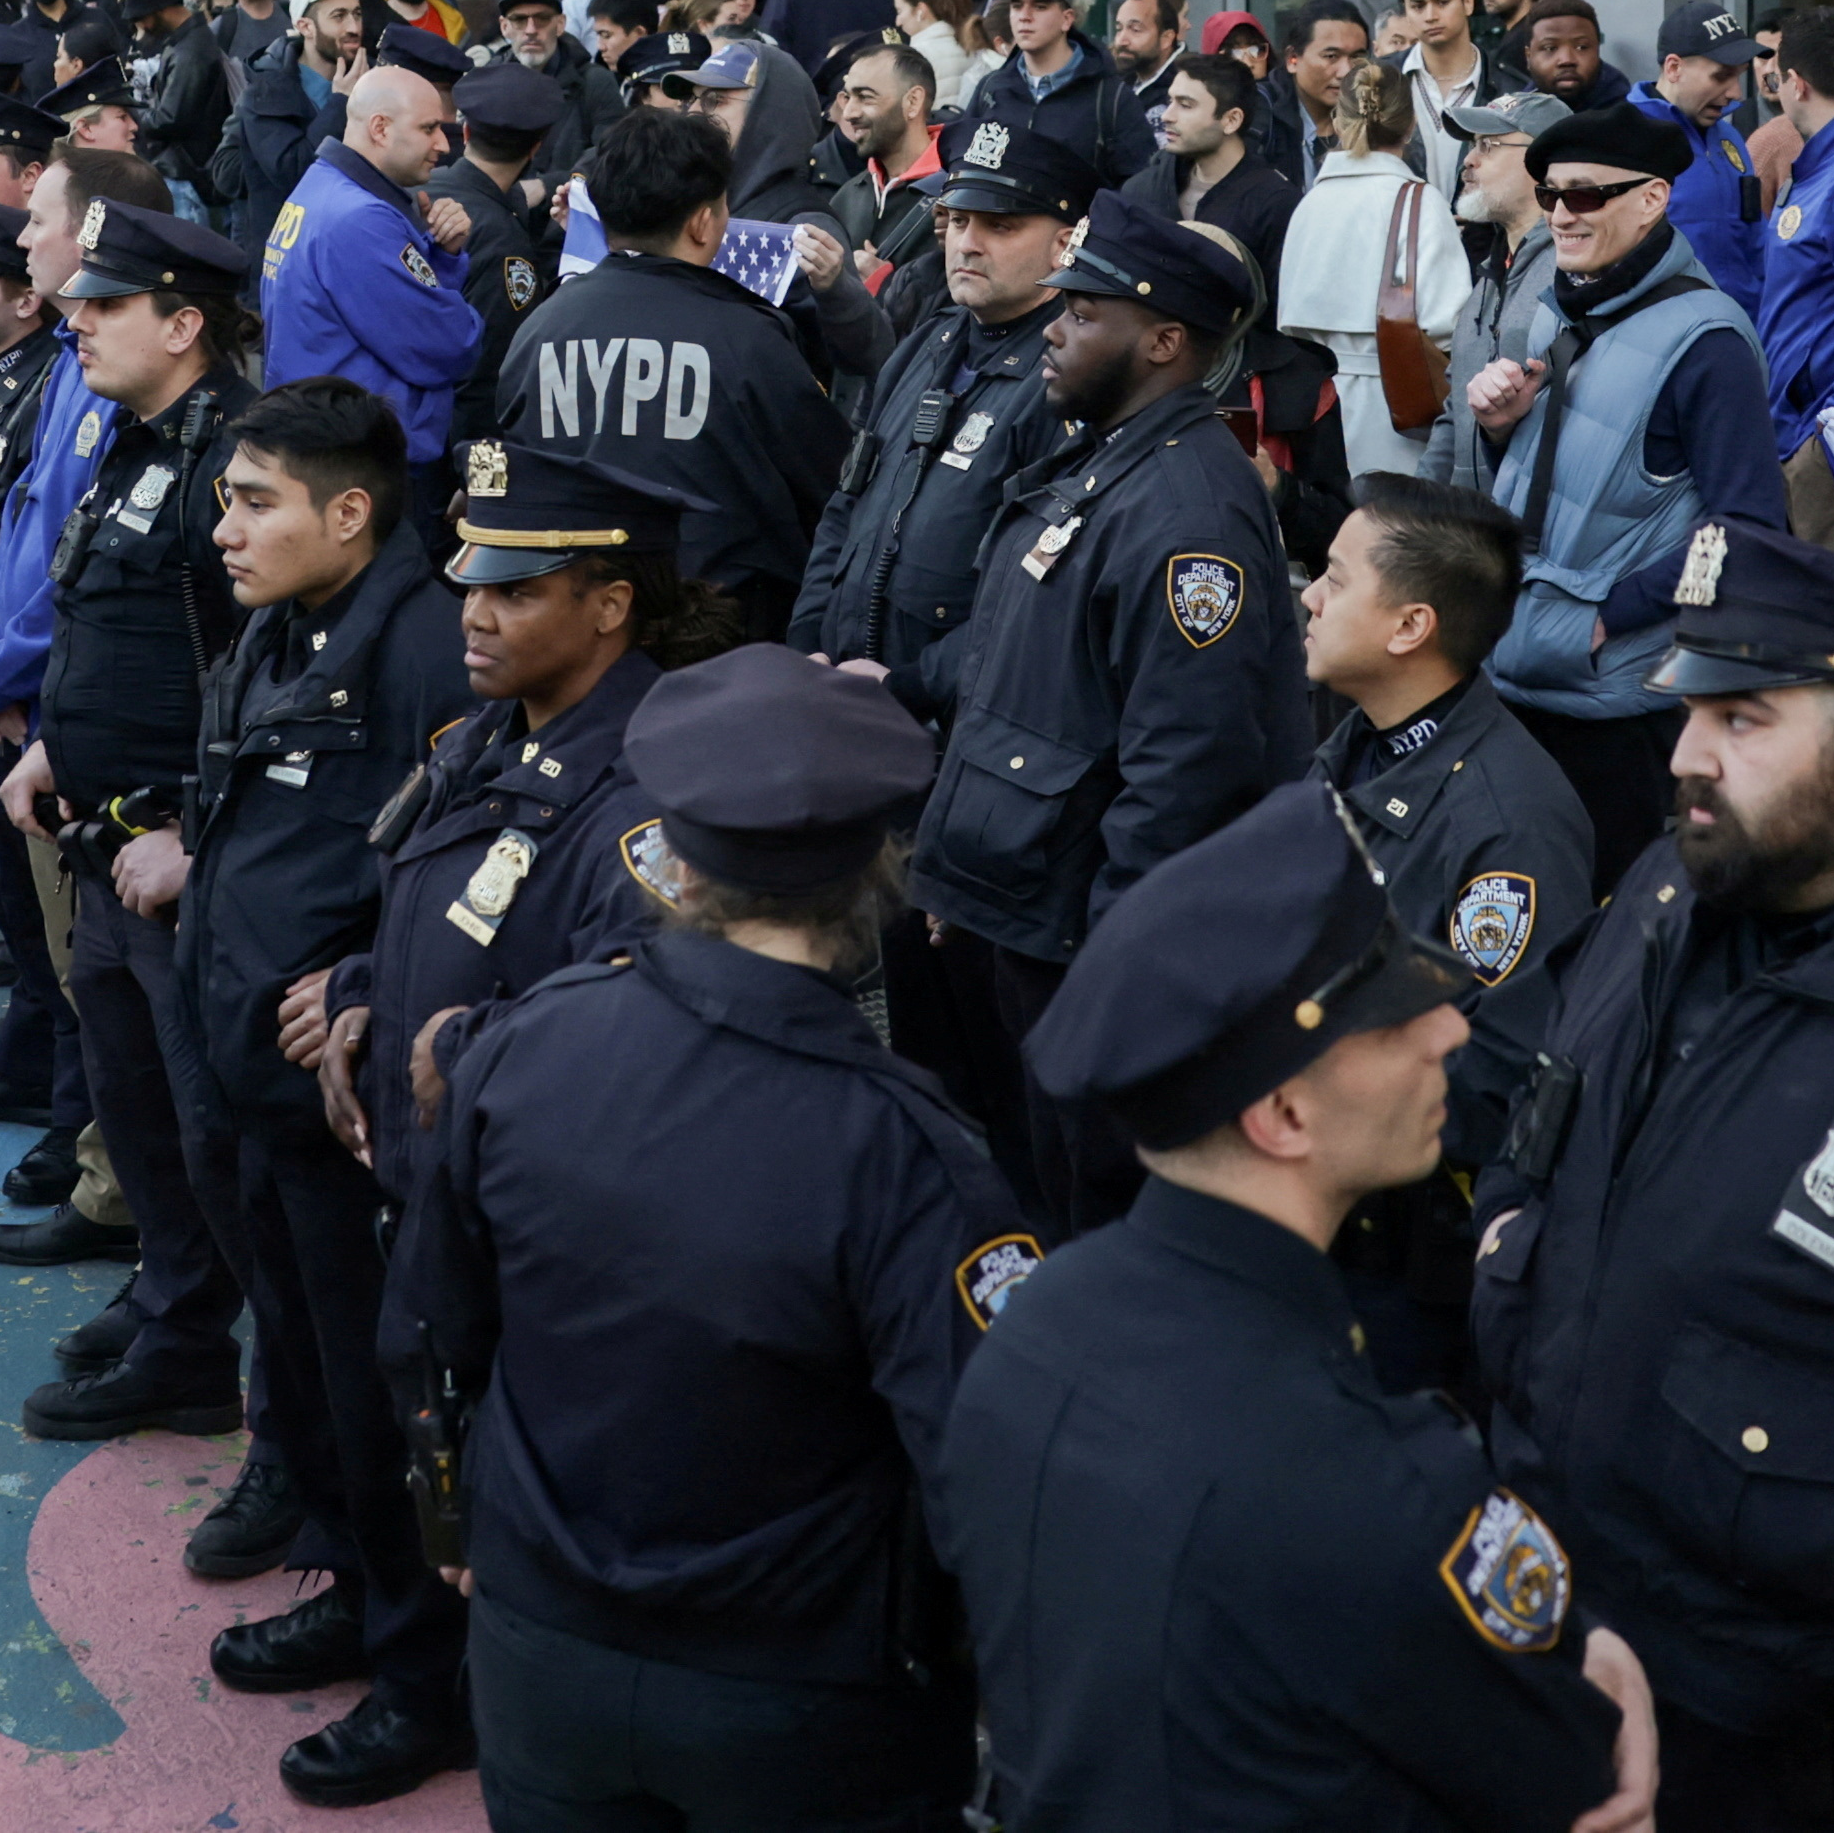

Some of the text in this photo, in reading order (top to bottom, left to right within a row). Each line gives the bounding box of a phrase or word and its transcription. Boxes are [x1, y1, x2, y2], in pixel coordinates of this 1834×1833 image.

[538, 337, 711, 441] NYPD
[1177, 571, 1236, 593] DEPARTMENT
[1191, 562, 1225, 578] POLICE
[1174, 593, 1195, 629] CITY OF
[1206, 599, 1237, 637] NEW YORK
[1387, 718, 1439, 755] NYPD
[1470, 877, 1510, 893] POLICE
[1453, 924, 1468, 954] CITY
[1496, 912, 1530, 974] NEW YORK
